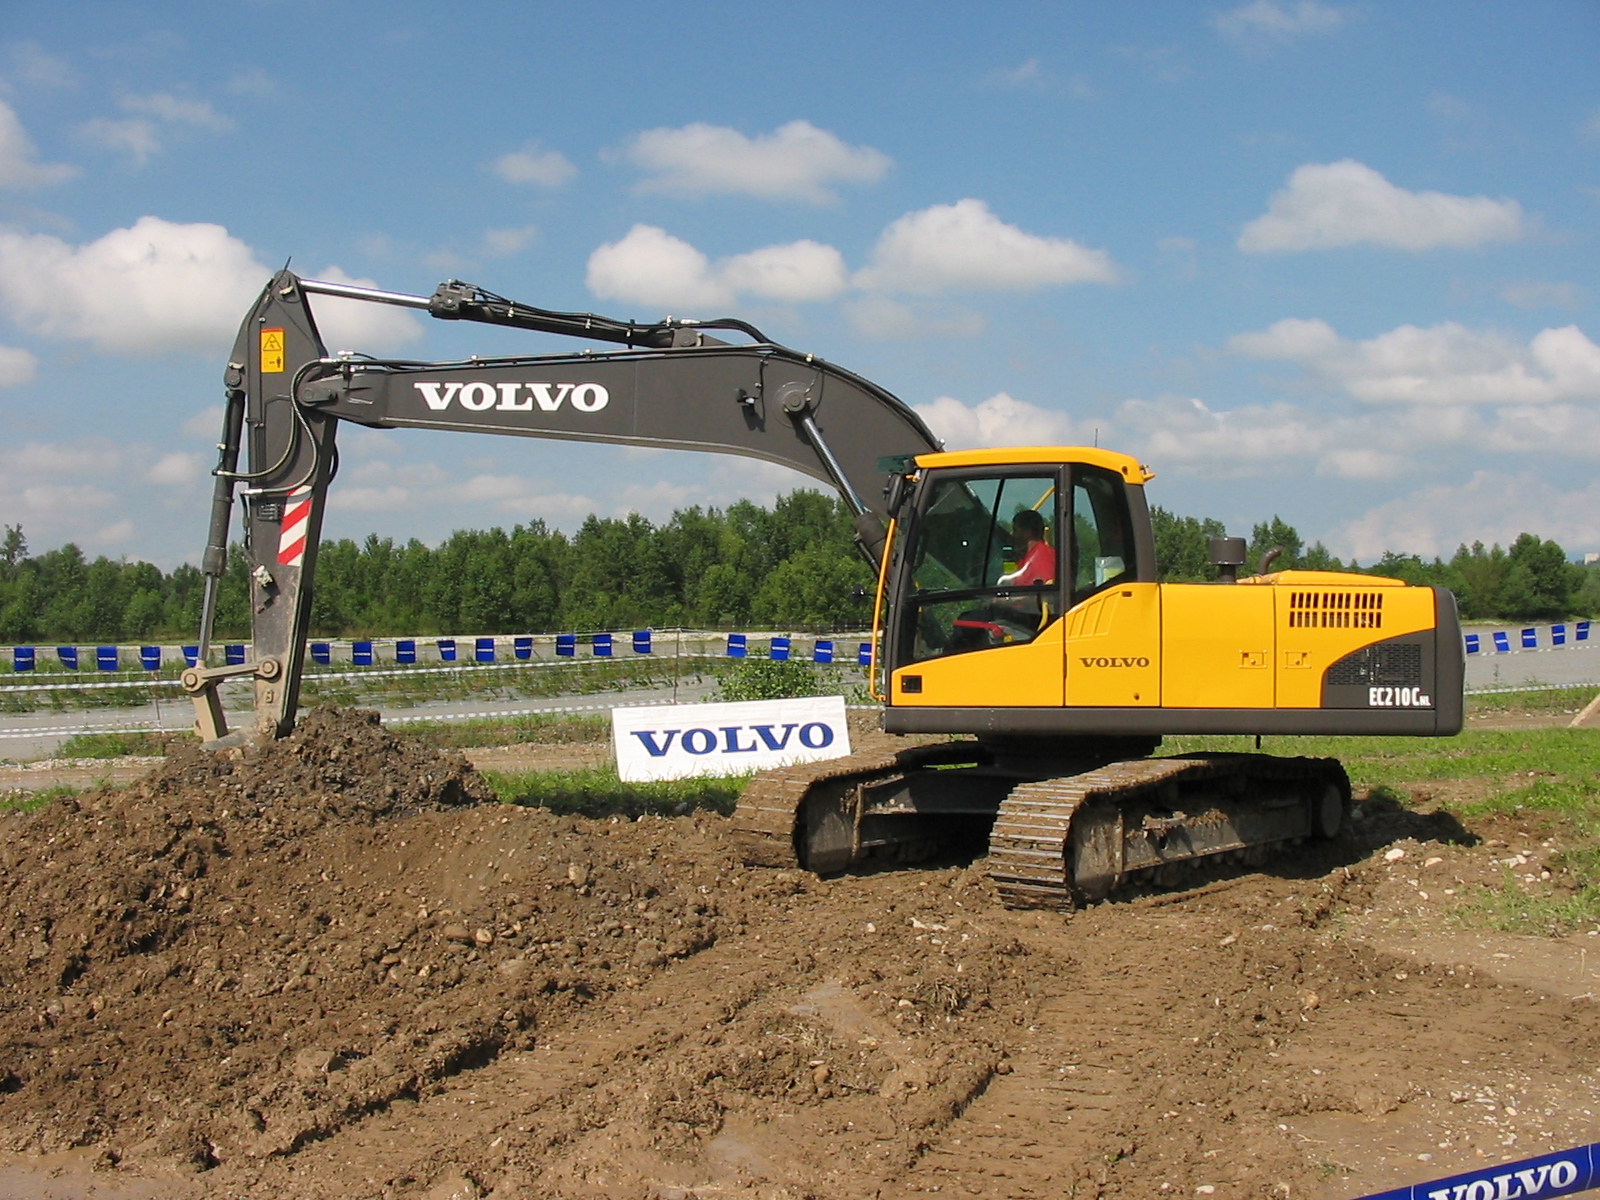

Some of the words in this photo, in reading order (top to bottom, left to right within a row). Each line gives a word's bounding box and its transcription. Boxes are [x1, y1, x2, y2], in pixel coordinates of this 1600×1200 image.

[413, 382, 609, 412] VOLVO
[1079, 657, 1150, 668] VOLVO
[630, 722, 834, 757] VOLVO
